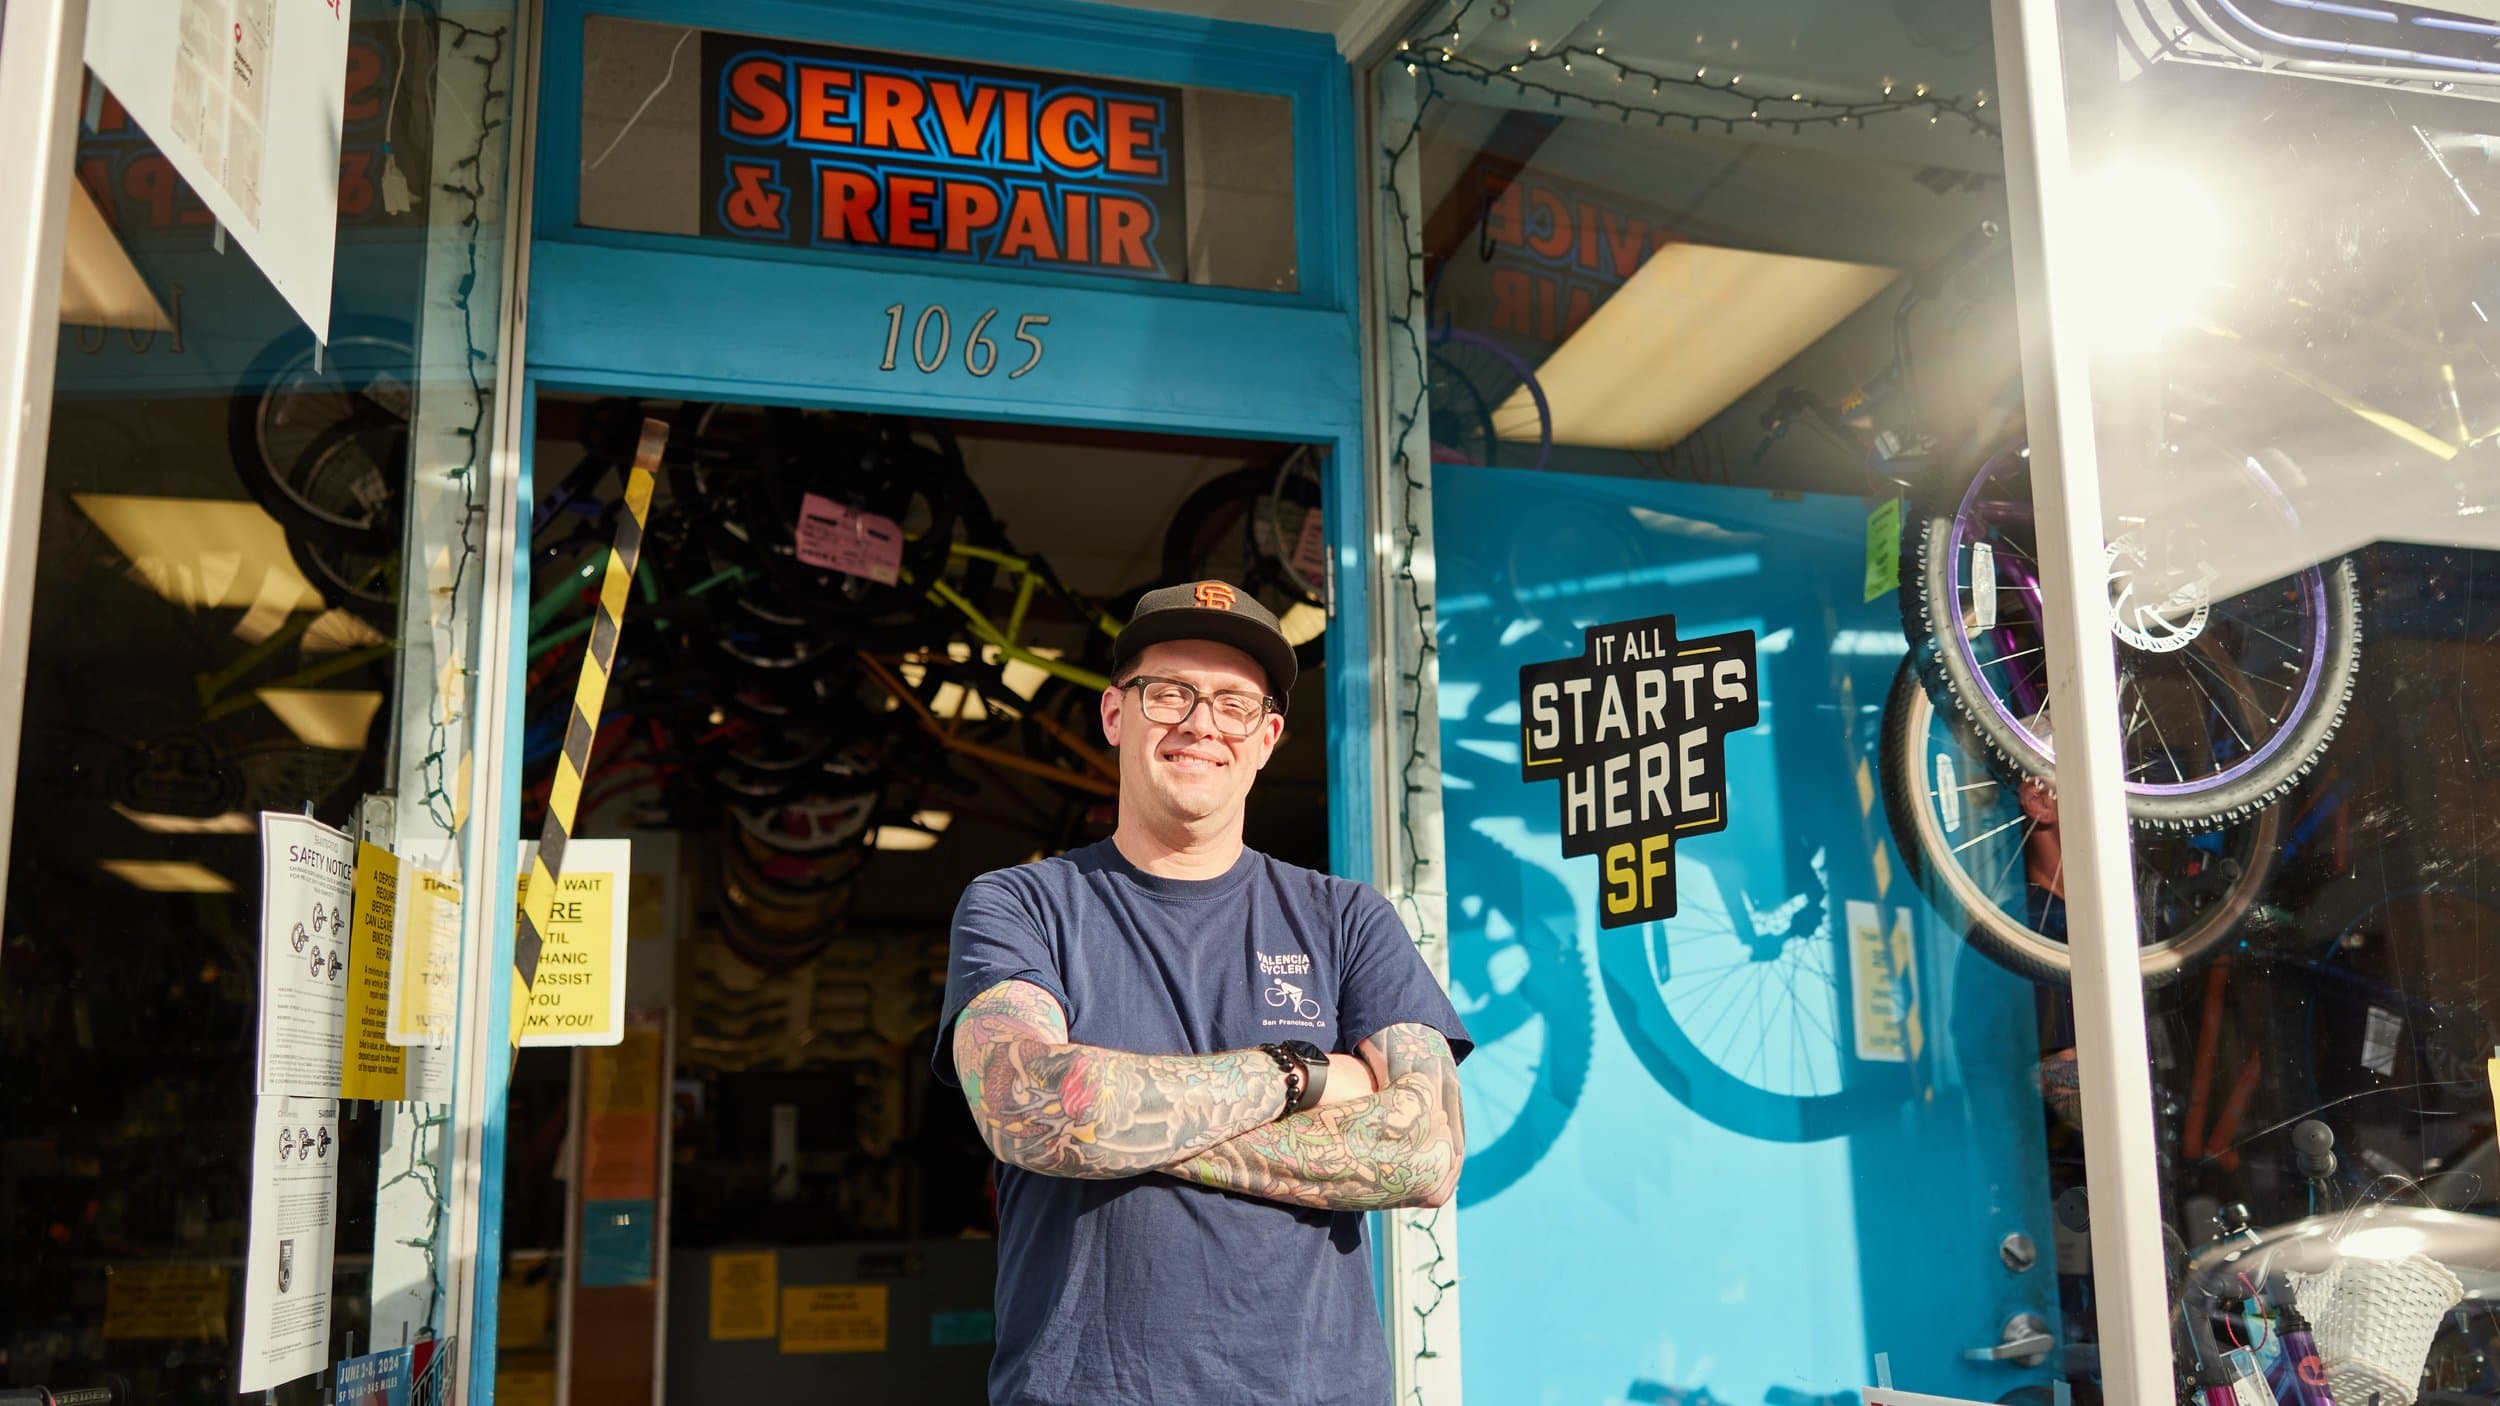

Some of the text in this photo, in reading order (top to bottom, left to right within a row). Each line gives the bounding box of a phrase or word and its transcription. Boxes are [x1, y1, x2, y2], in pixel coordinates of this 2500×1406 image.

[727, 58, 1162, 177] SERVICE
[725, 165, 1156, 270] & REPAIR
[879, 302, 1052, 380] 1065
[1595, 627, 1667, 667] IT ALL
[1531, 657, 1749, 751] STARTS
[1566, 725, 1711, 837] HERE
[289, 845, 352, 881] SAFETY NOTICE
[1605, 832, 1670, 915] SF
[563, 879, 602, 892] WAIT
[371, 899, 392, 917] BEFORE
[516, 901, 584, 921] HRE
[365, 912, 393, 933] CAN LEAVE
[547, 931, 570, 945] TIL
[539, 952, 588, 965] HANIC
[1256, 951, 1310, 966] VALENCIA
[1259, 962, 1310, 975] CYCLERY
[536, 973, 593, 985] ASSIST
[529, 993, 561, 1007] YOU
[555, 1014, 594, 1027] YOU!
[1278, 1019, 1315, 1028] Francisco,
[340, 1364, 360, 1385] JUNE
[378, 1355, 399, 1374] 2024
